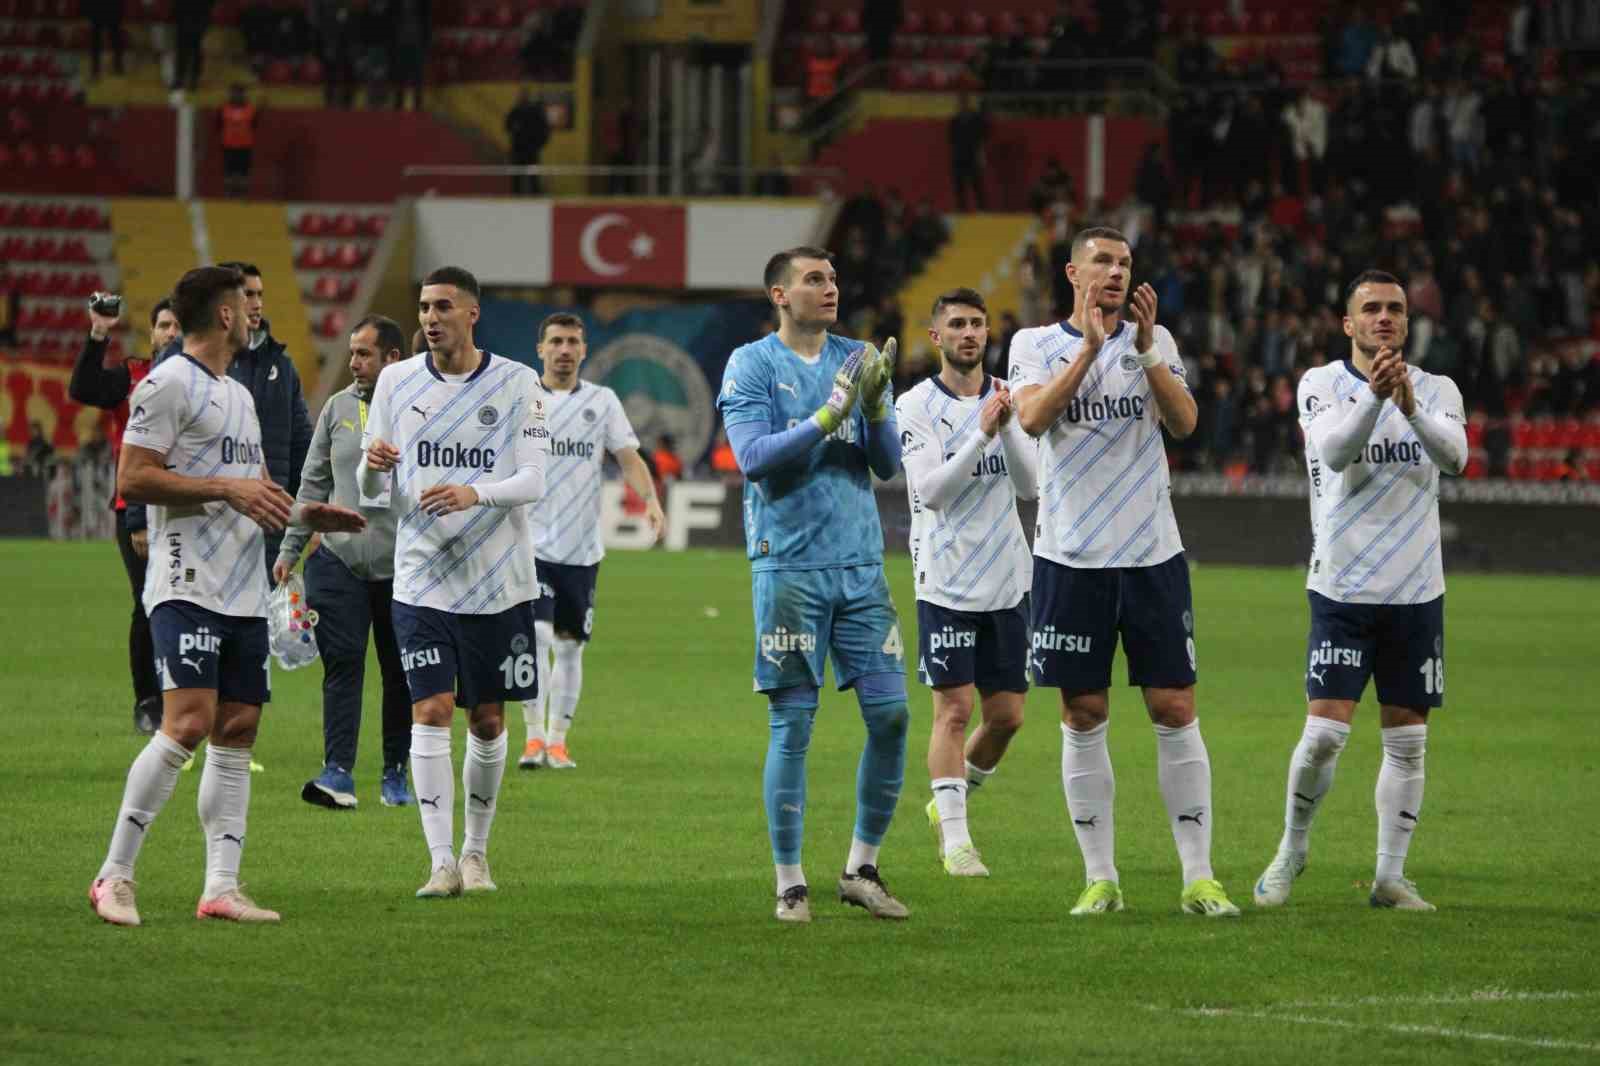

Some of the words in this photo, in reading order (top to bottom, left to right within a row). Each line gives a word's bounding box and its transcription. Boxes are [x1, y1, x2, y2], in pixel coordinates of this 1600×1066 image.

[1067, 395, 1144, 424] Otokoç
[417, 440, 496, 473] Otokoç
[1031, 626, 1091, 653] pürsu
[1310, 640, 1362, 671] pürsu
[499, 653, 536, 690] 16
[1419, 657, 1444, 695] 18
